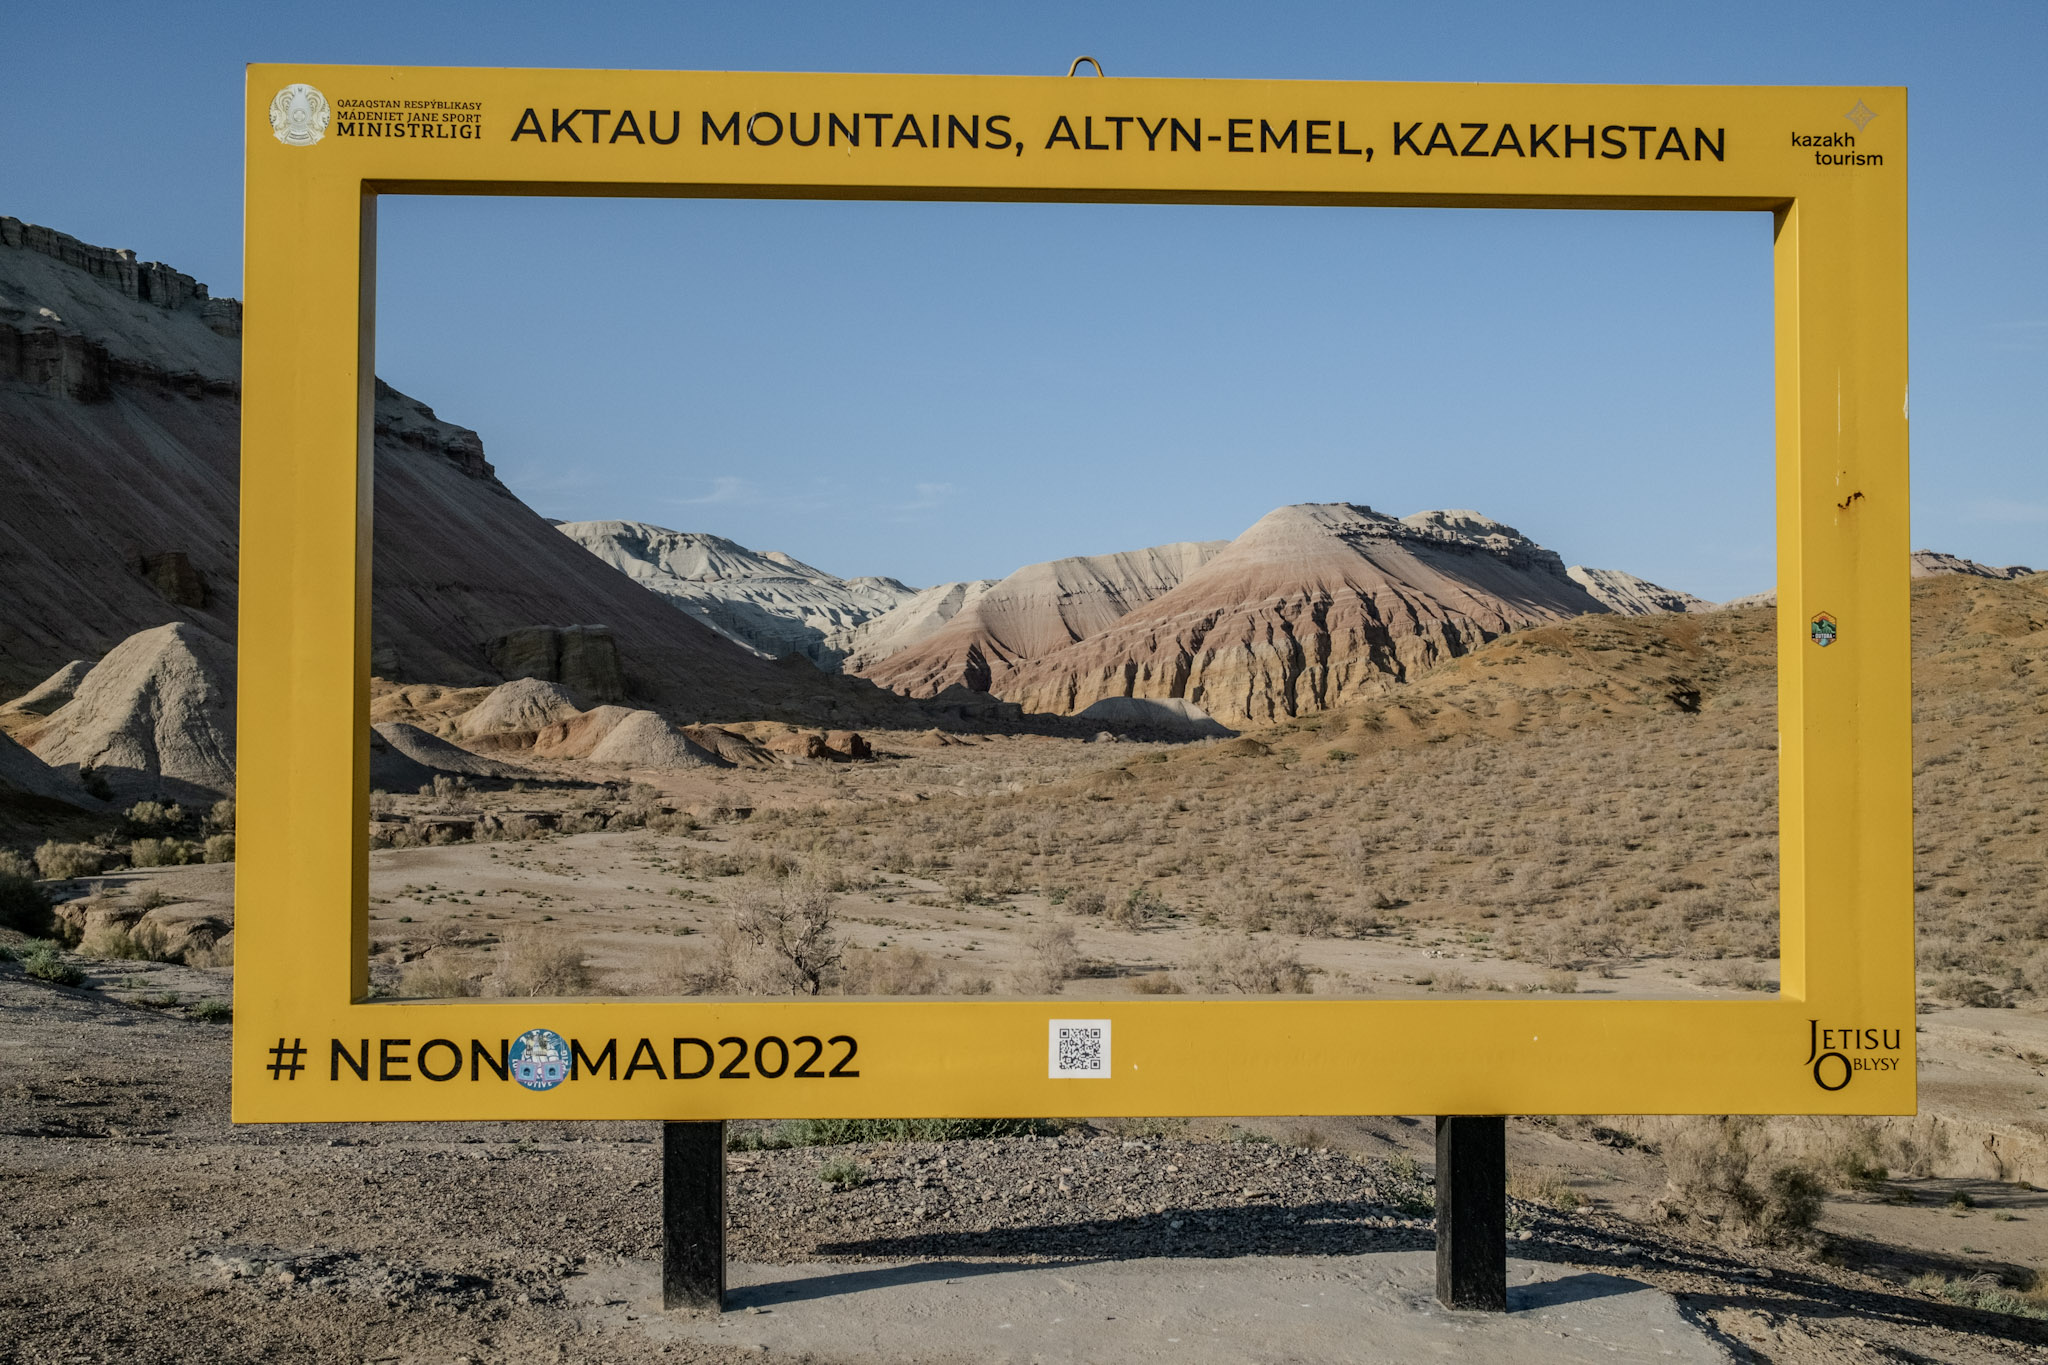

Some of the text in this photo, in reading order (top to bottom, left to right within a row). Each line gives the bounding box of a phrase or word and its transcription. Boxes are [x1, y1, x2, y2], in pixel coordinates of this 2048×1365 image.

[337, 99, 401, 108] QAZAQSTAN
[407, 112, 439, 123] JANE
[442, 113, 482, 123] SPORT
[337, 121, 482, 139] MINISTRLIGI
[510, 107, 1725, 163] AKTAU MOUNTAINS, ALTYN-EMEL, KAZAKHSTAN
[1791, 131, 1855, 147] kazakh
[1815, 150, 1884, 166] tourism
[330, 1034, 860, 1082] NEONMAD2022
